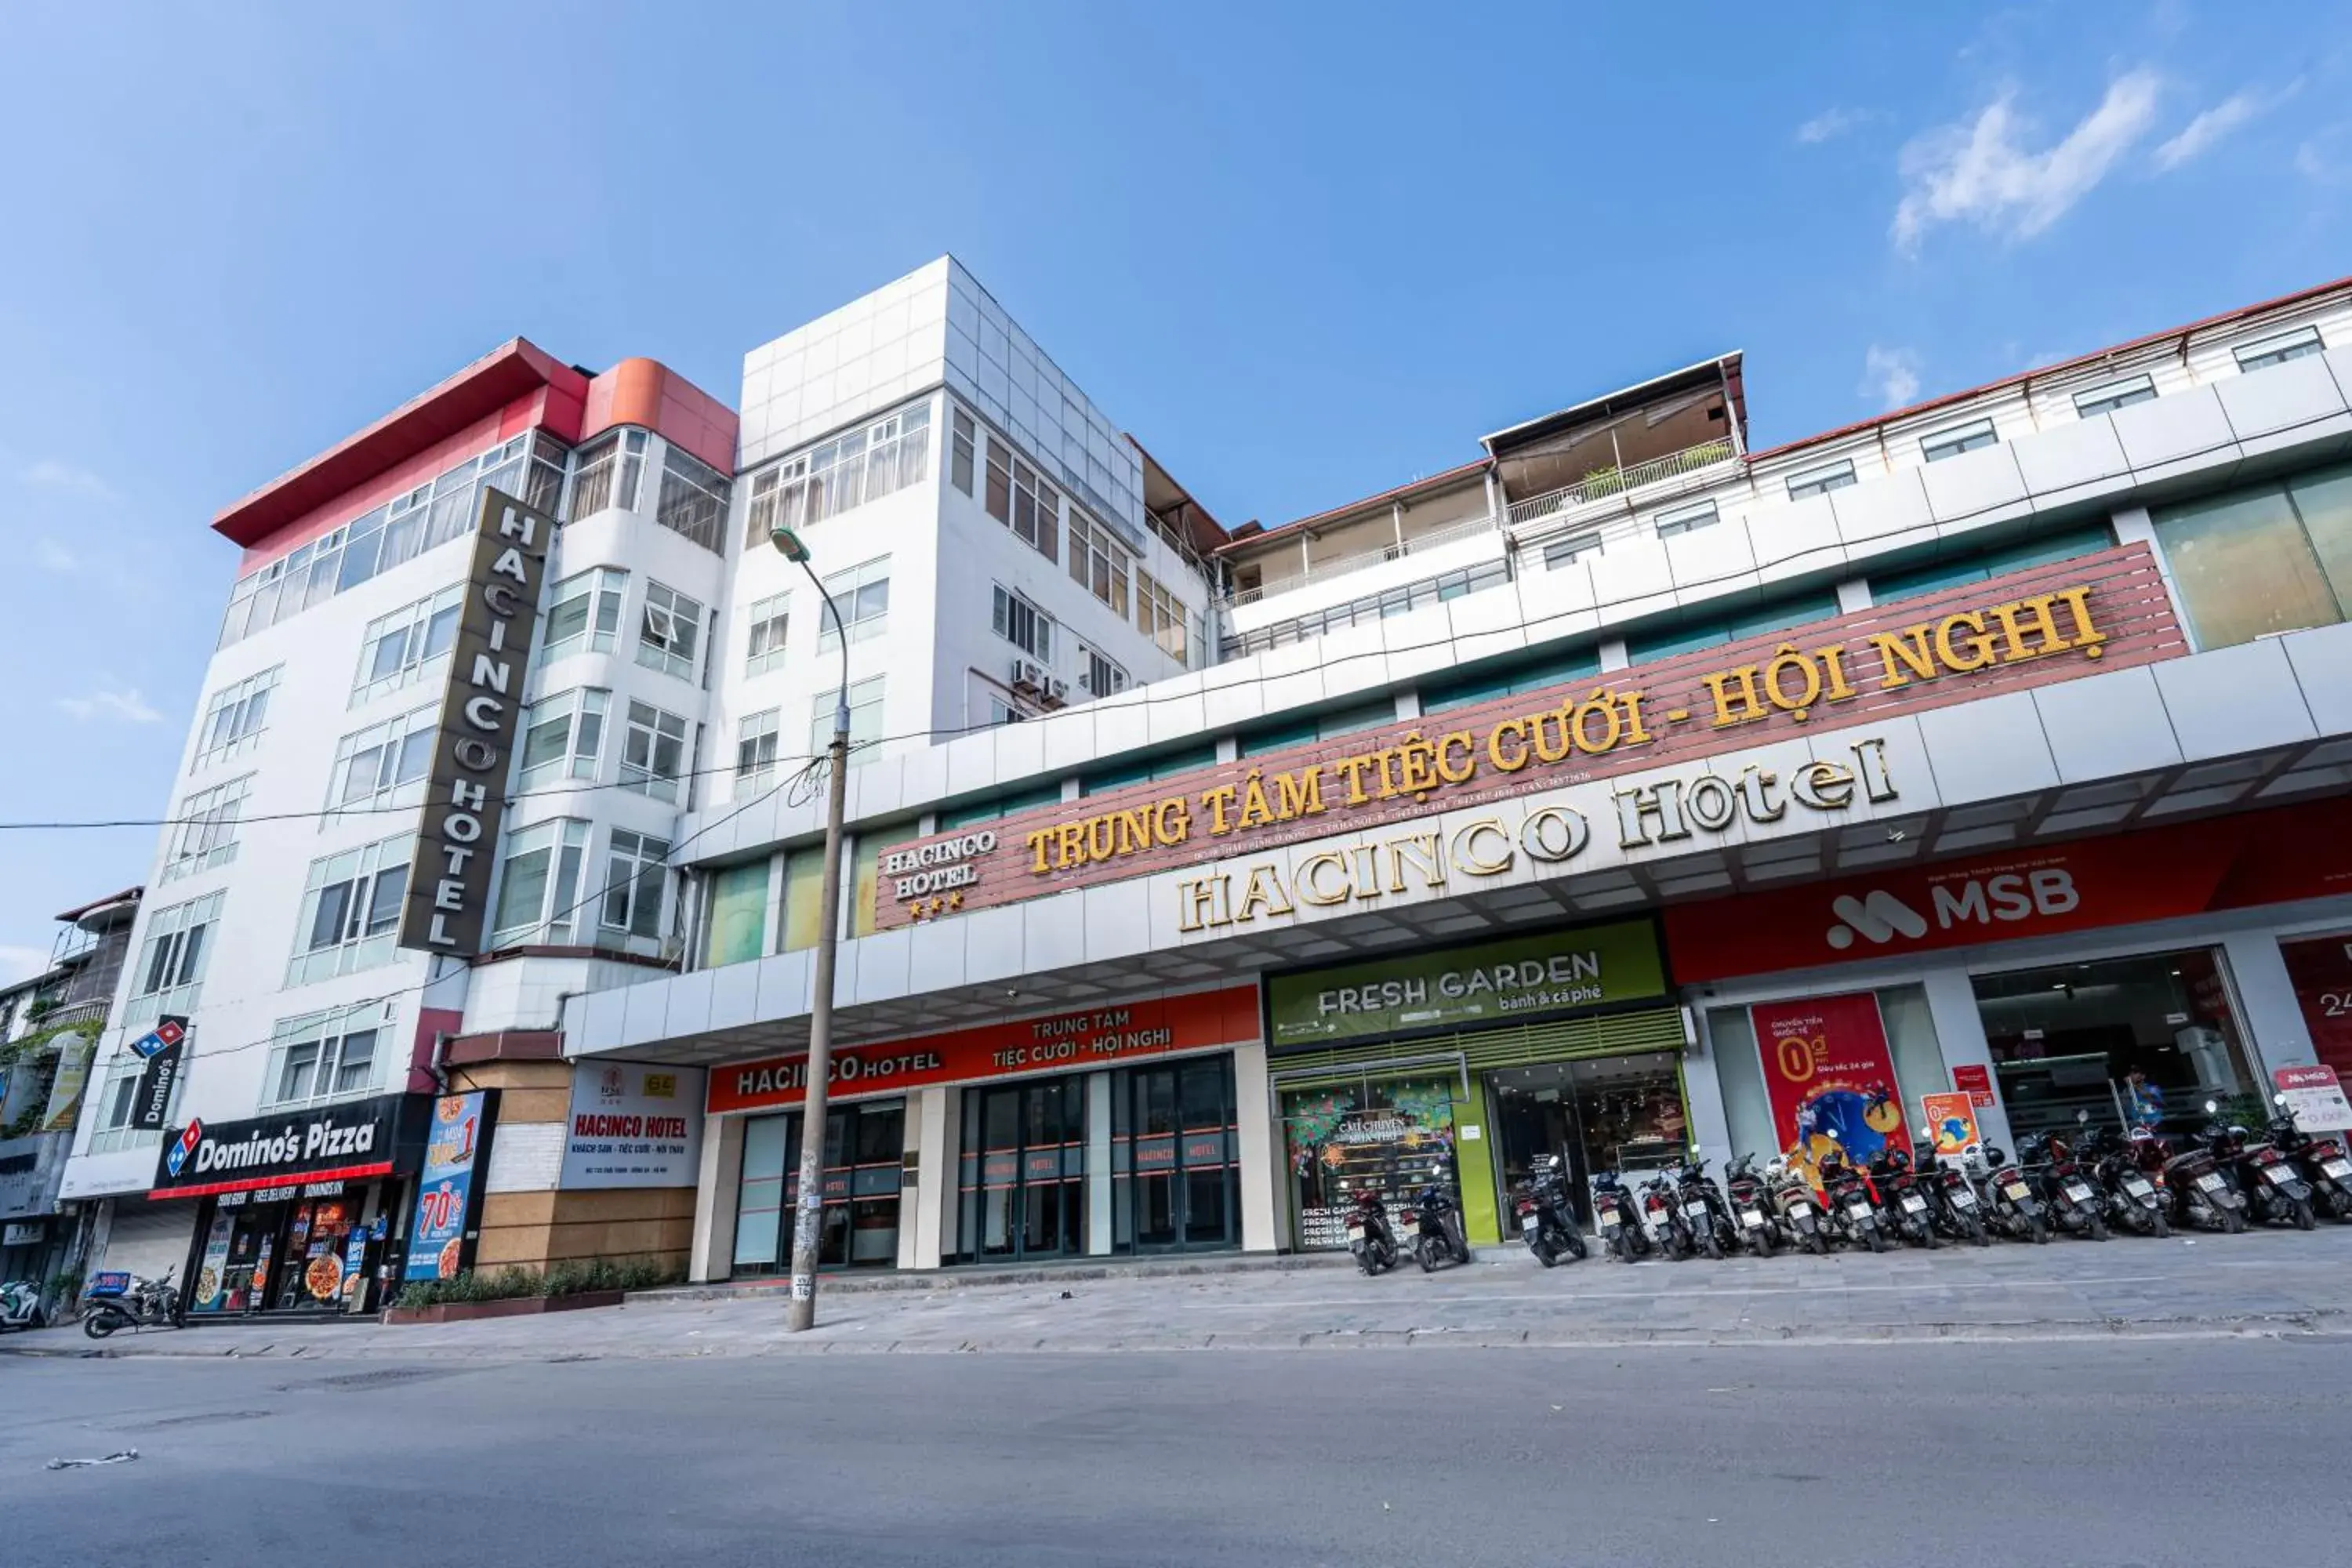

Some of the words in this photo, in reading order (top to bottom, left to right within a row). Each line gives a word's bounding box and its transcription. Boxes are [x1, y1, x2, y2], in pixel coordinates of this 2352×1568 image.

[454, 506, 535, 771] HACINCO
[1027, 796, 1192, 875] TRUNG
[1202, 770, 1328, 835] TÂM
[1337, 729, 1477, 804] TIỆC
[1488, 686, 1652, 772] CƯỚI
[1703, 641, 1857, 728] HỘI
[1868, 585, 2107, 689] NGHỊ
[429, 779, 486, 946] HOTEL
[885, 830, 996, 875] HACINCO
[1178, 805, 1591, 932] HACINCO
[1610, 738, 1900, 851] Hotel
[895, 864, 979, 901] HOTEL
[1931, 868, 2080, 929] MSB
[1318, 977, 1426, 1017] FRESH
[1439, 949, 1600, 999] GARDEN
[992, 1045, 1027, 1072] TIỆC
[1092, 1032, 1123, 1057] HỘI
[1127, 1028, 1171, 1049] NGHỊ
[1032, 1016, 1088, 1039] TRUNG
[1093, 1007, 1130, 1029] TÂM
[145, 1058, 174, 1123] Domino's
[738, 1055, 858, 1095] HACICO
[863, 1053, 940, 1078] HOTEL
[196, 1125, 300, 1173] Domino's
[304, 1120, 376, 1160] Pizza
[573, 1113, 643, 1138] HACINCO
[645, 1115, 688, 1138] HOTEL
